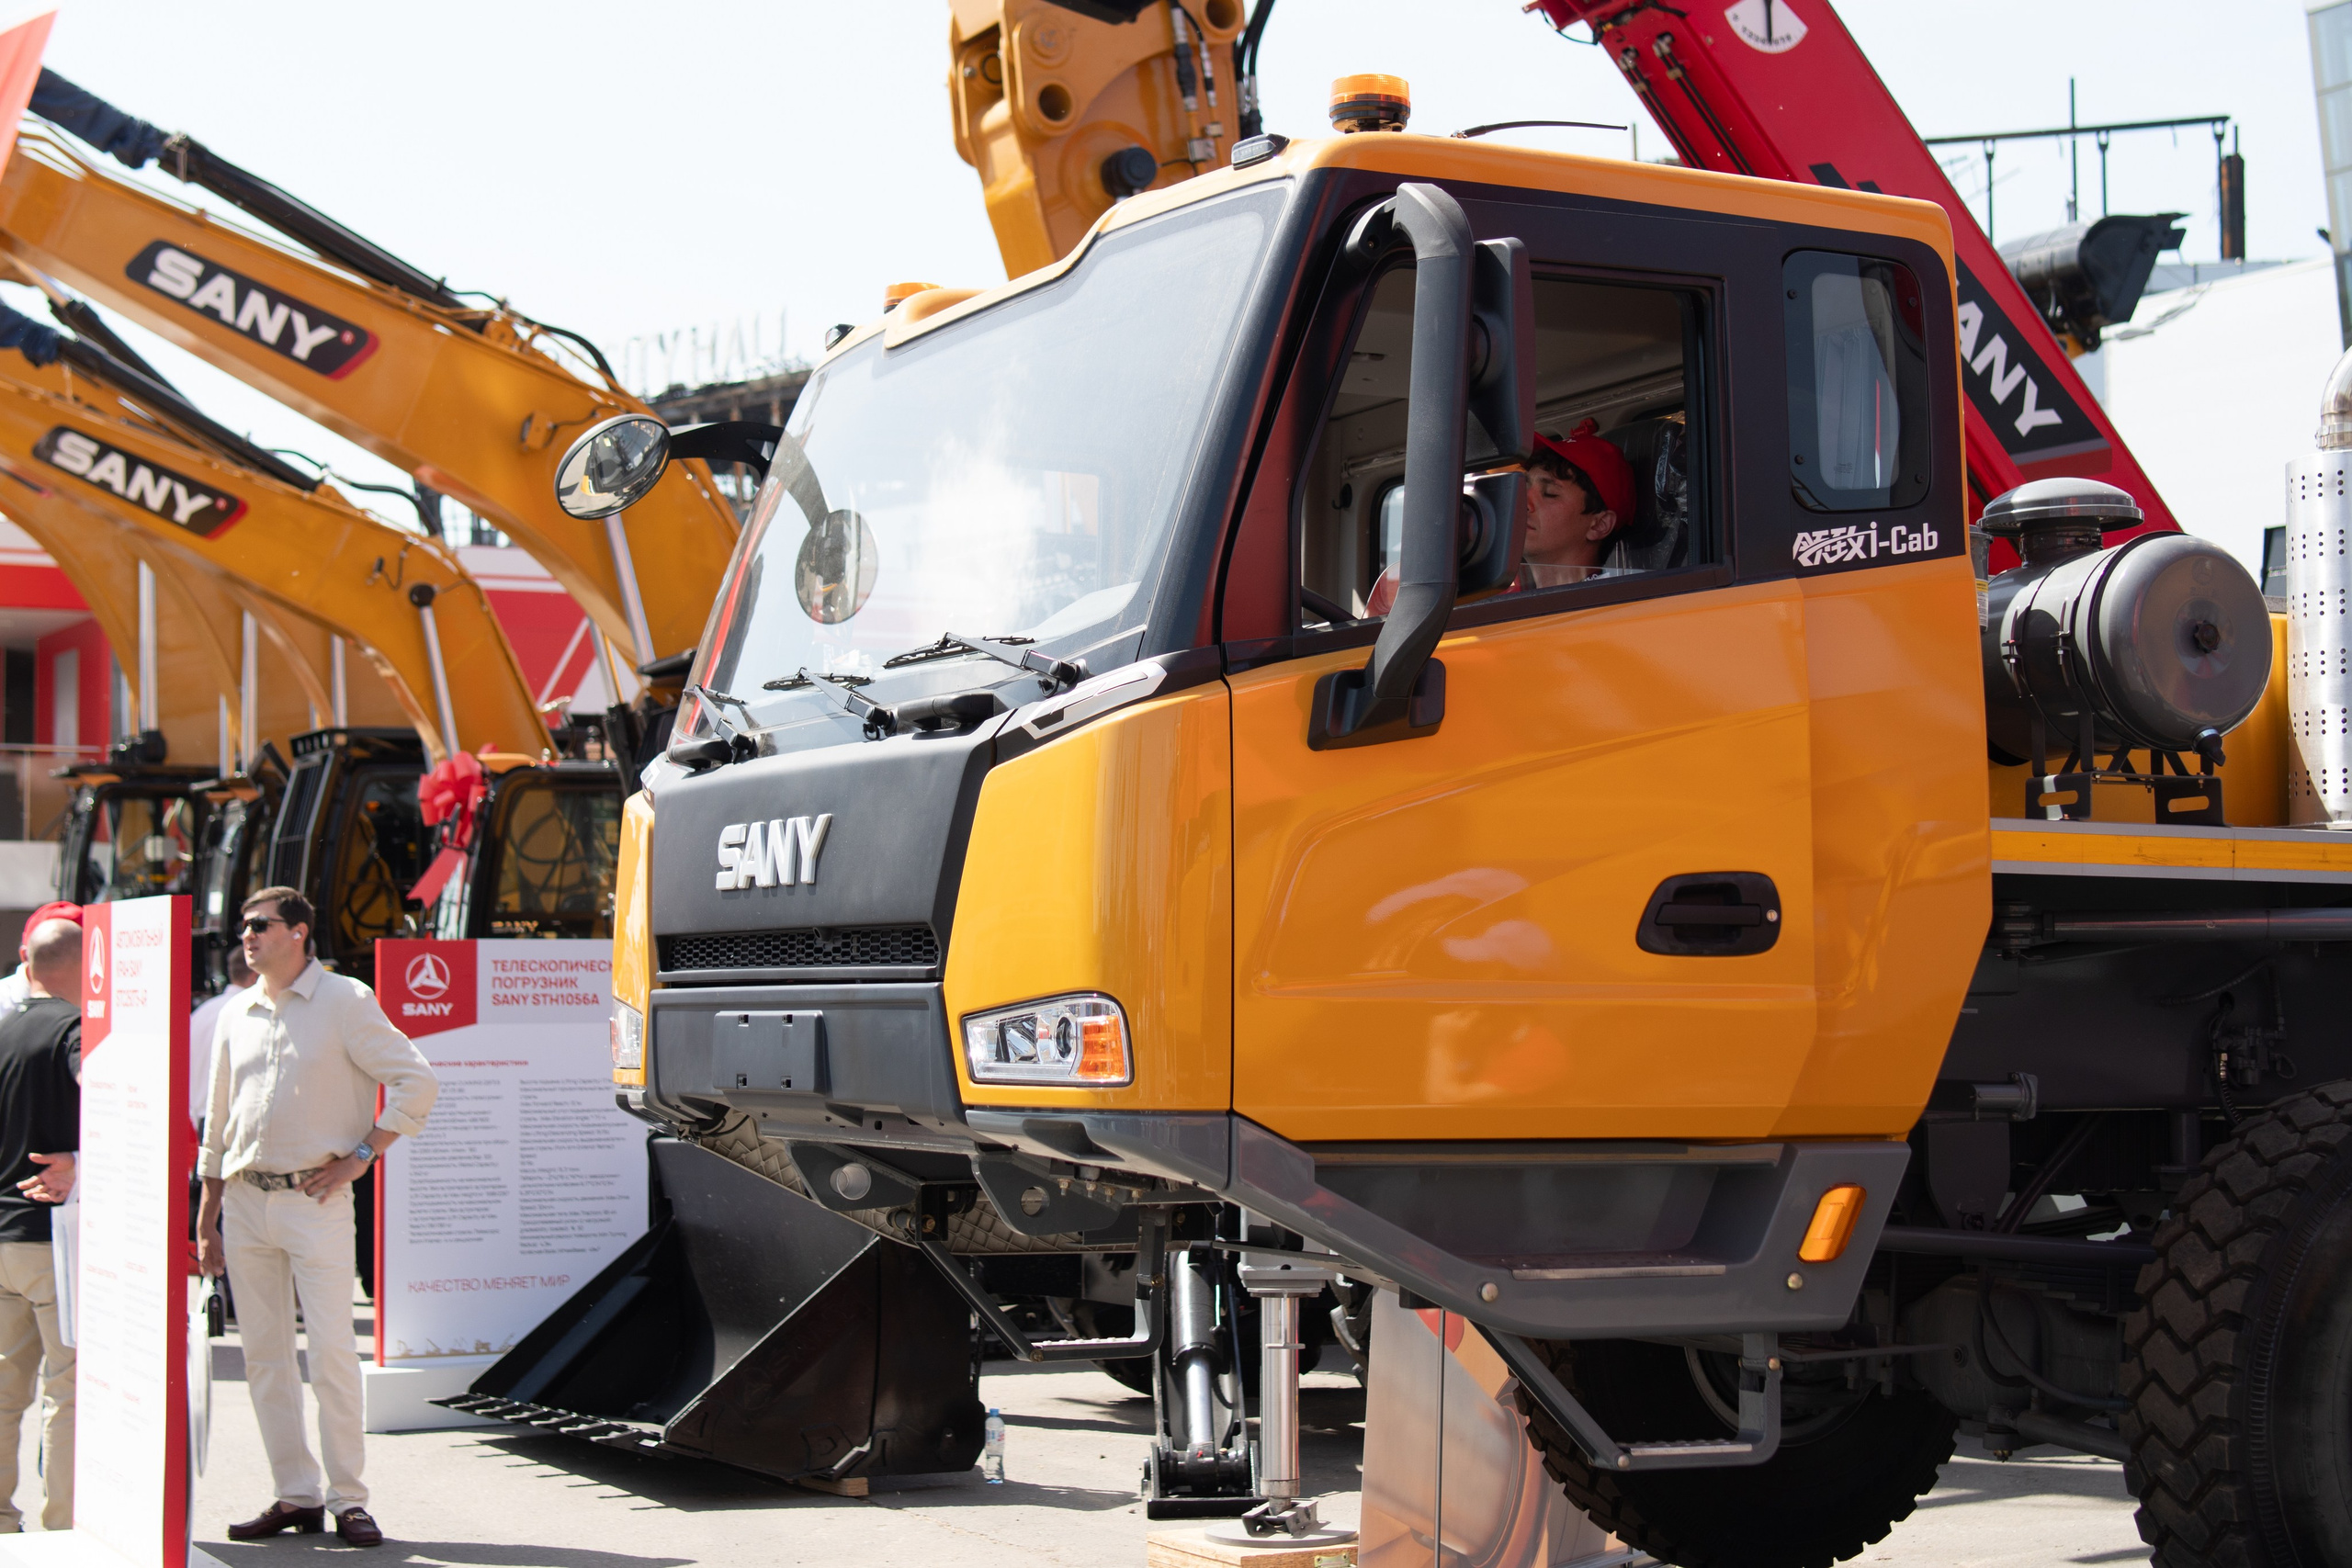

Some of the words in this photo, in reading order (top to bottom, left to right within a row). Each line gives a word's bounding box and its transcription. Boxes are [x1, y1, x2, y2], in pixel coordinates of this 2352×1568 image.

[147, 247, 339, 362] SANY
[1957, 277, 2064, 438] ANY
[51, 431, 213, 525] SANY
[715, 813, 834, 891] SANY
[492, 976, 579, 989] ПОГРУЗНИК
[492, 992, 530, 1007] SANY
[532, 992, 600, 1007] STH1056A
[401, 1002, 454, 1017] SANY
[407, 1278, 481, 1293] КАЧЕСТВО
[483, 1275, 537, 1291] МЕНЯЕТ
[539, 1273, 571, 1288] МИР
